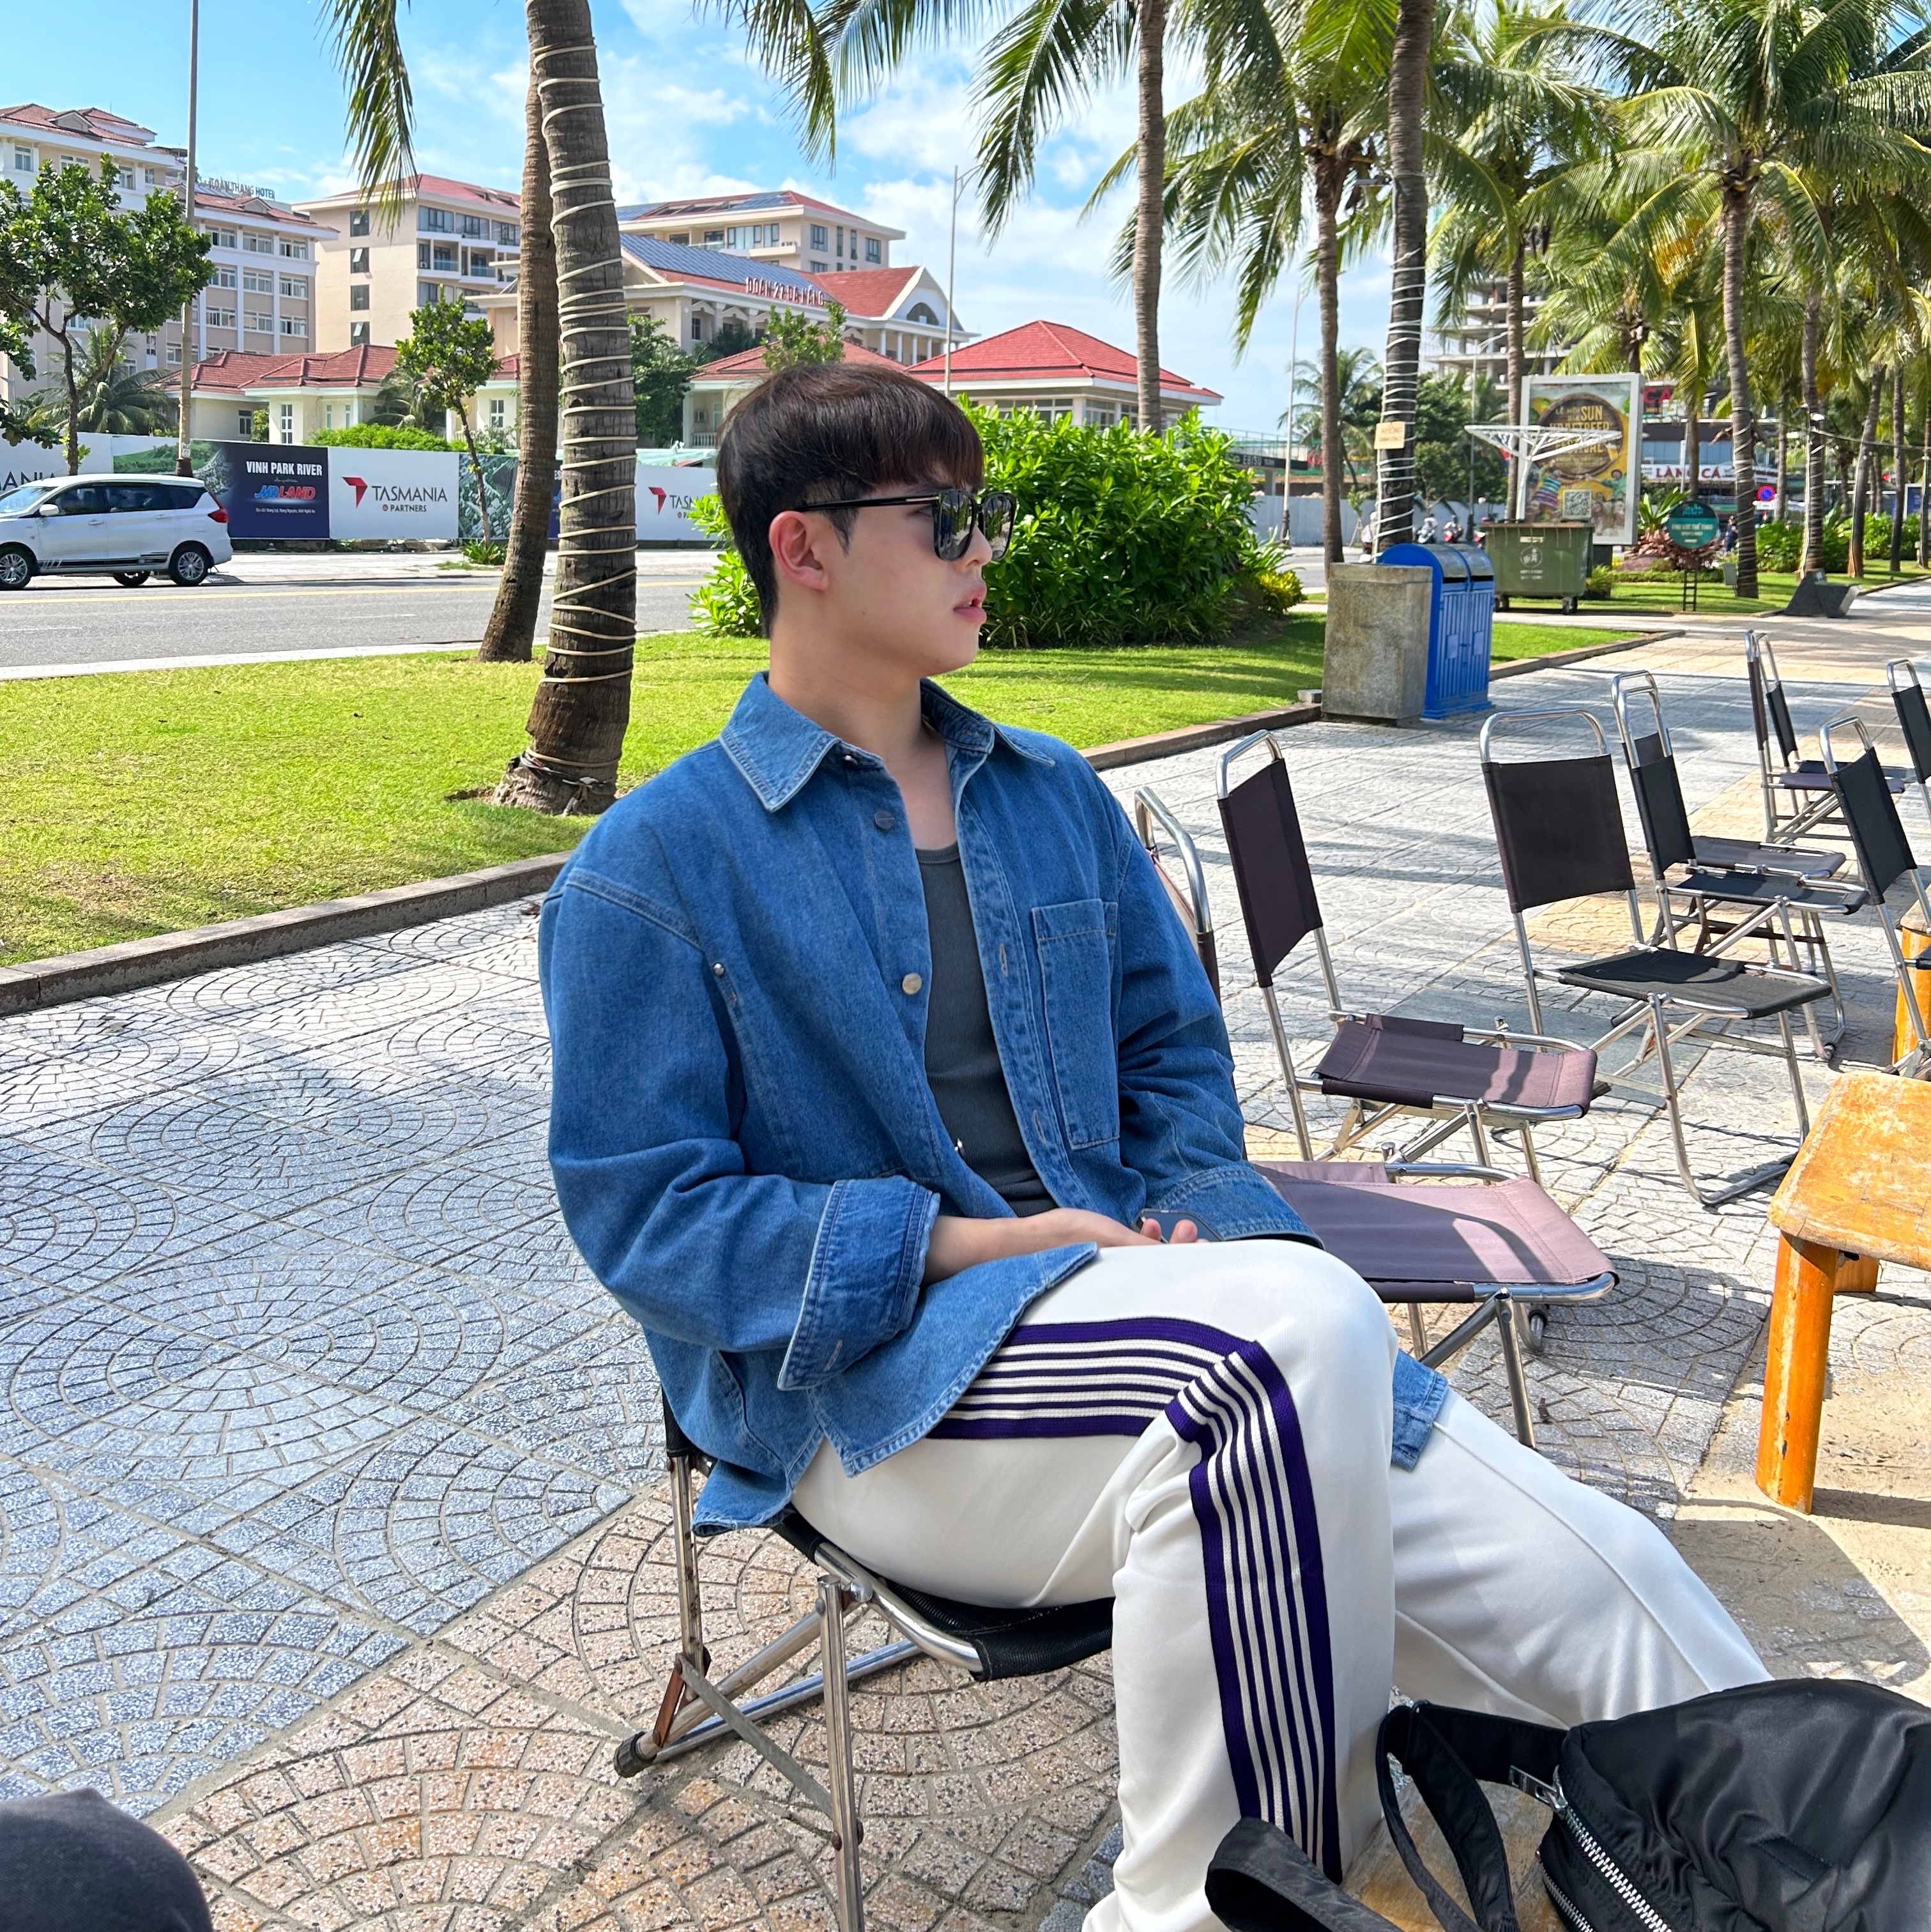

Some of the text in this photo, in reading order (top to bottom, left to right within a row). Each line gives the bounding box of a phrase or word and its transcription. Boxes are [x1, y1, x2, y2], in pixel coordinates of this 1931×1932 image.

[256, 187, 275, 199] HOTEL
[1581, 405, 1603, 422] SUN
[246, 461, 323, 476] VINH PARK RIVER
[371, 486, 448, 502] TASMANIA
[390, 504, 427, 512] PARTNERS
